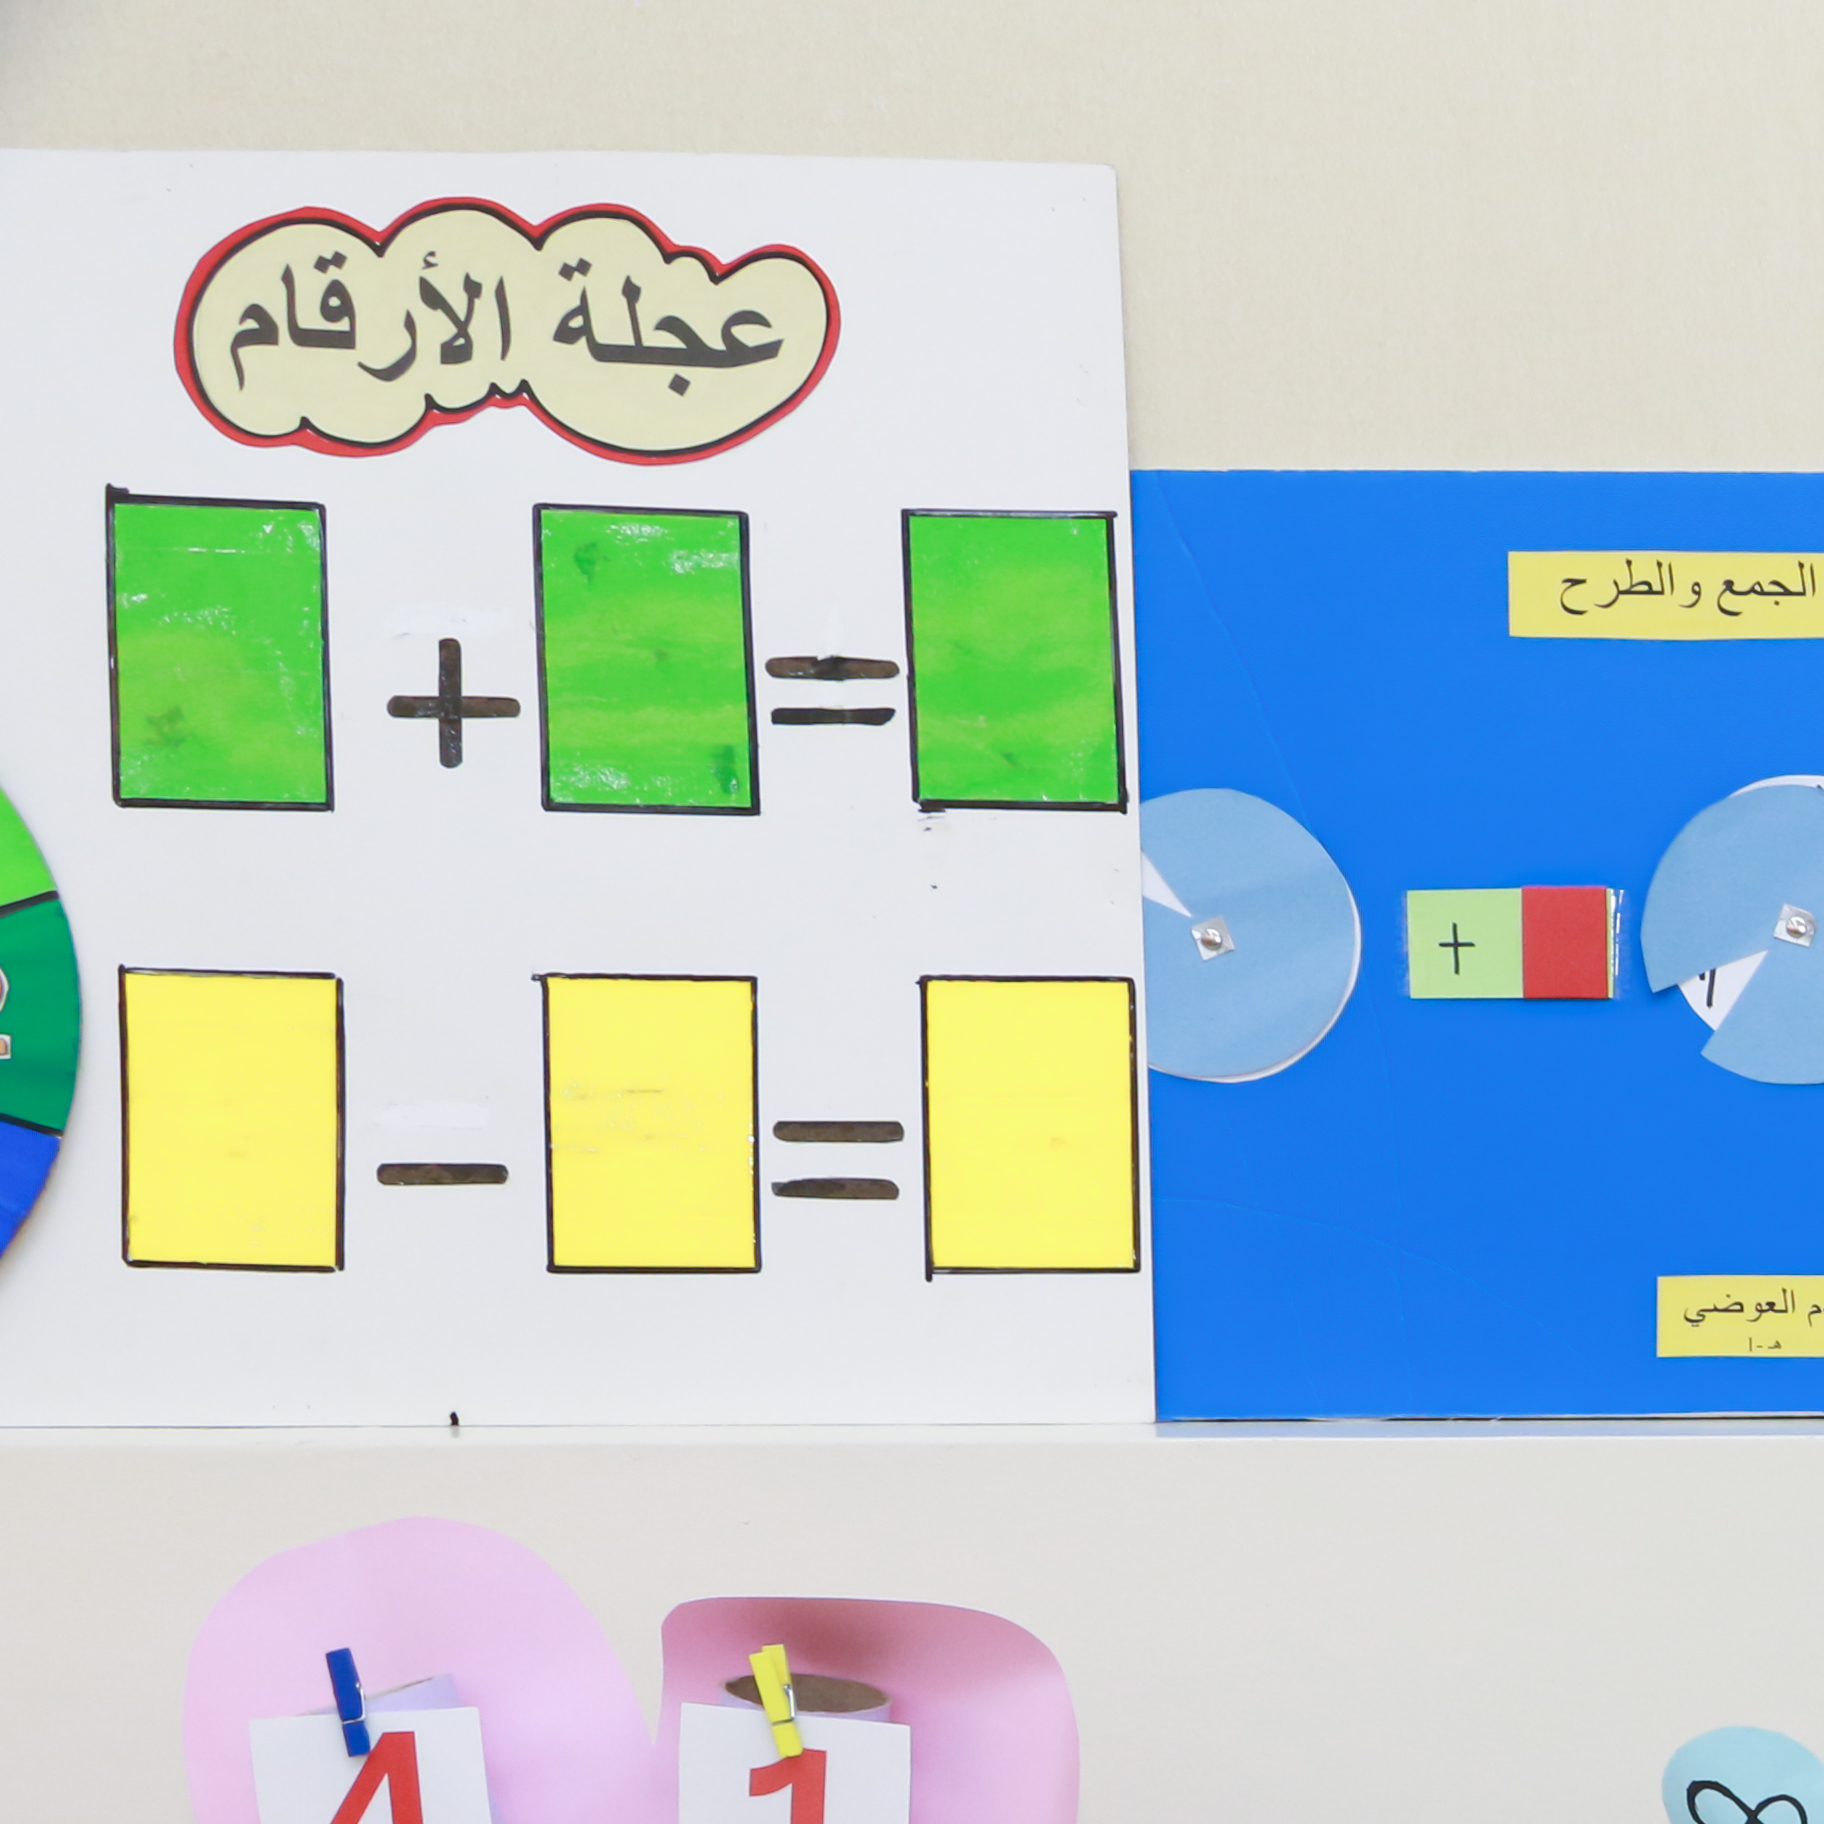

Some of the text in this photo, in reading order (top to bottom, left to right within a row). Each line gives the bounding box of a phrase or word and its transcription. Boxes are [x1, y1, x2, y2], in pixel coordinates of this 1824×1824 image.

[230, 248, 783, 395] عجلة الأرقام
[1714, 562, 1816, 615] الجمع
[1683, 1287, 1796, 1327] العوضي
